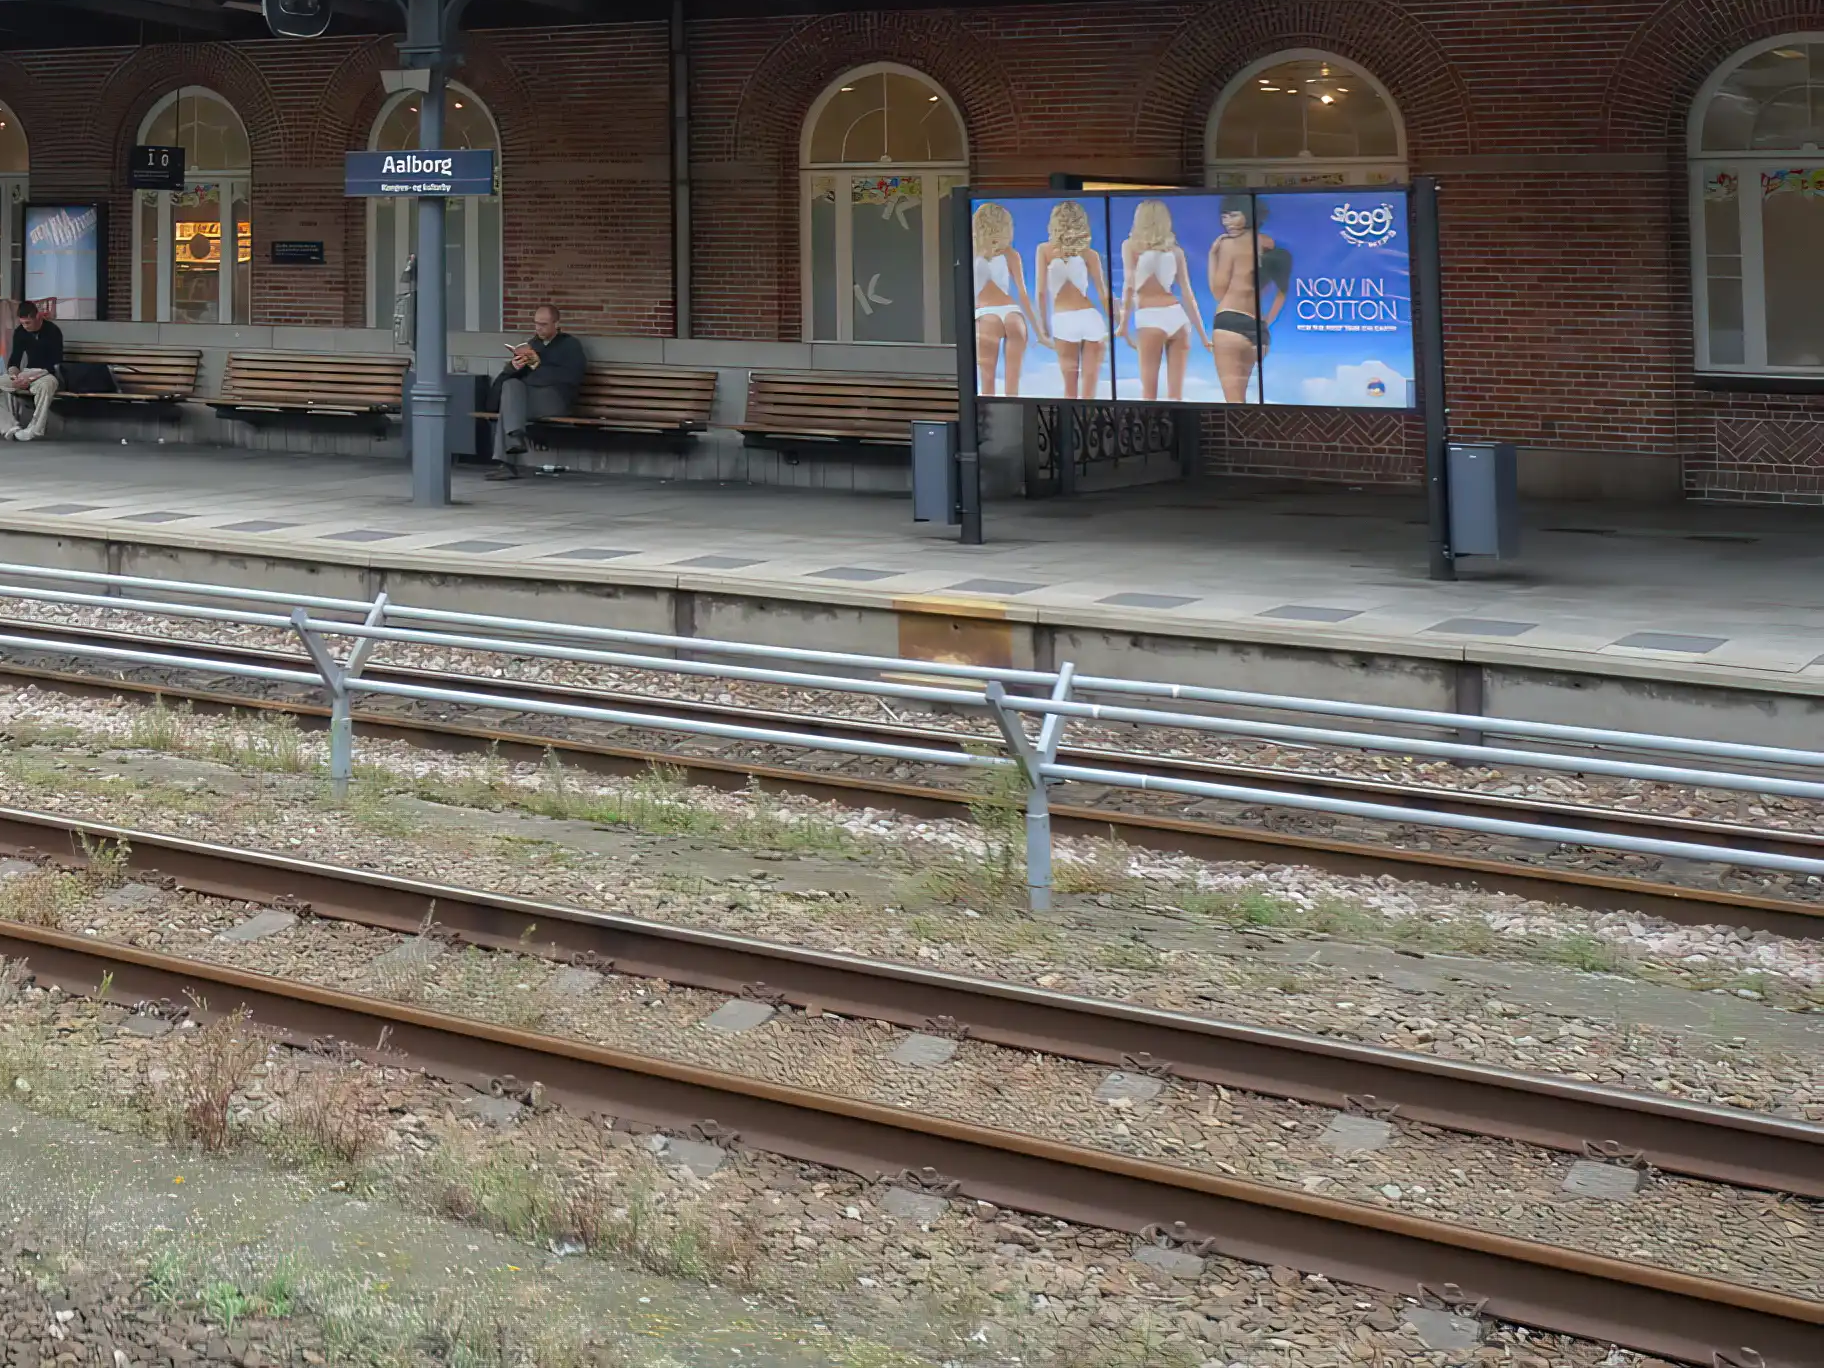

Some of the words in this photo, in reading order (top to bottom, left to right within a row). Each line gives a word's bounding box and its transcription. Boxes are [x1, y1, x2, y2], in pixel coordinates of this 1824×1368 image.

[381, 155, 453, 176] Aalborg
[1296, 277, 1355, 297] NOW
[1361, 278, 1384, 296] IN
[1297, 300, 1397, 320] COTTON
